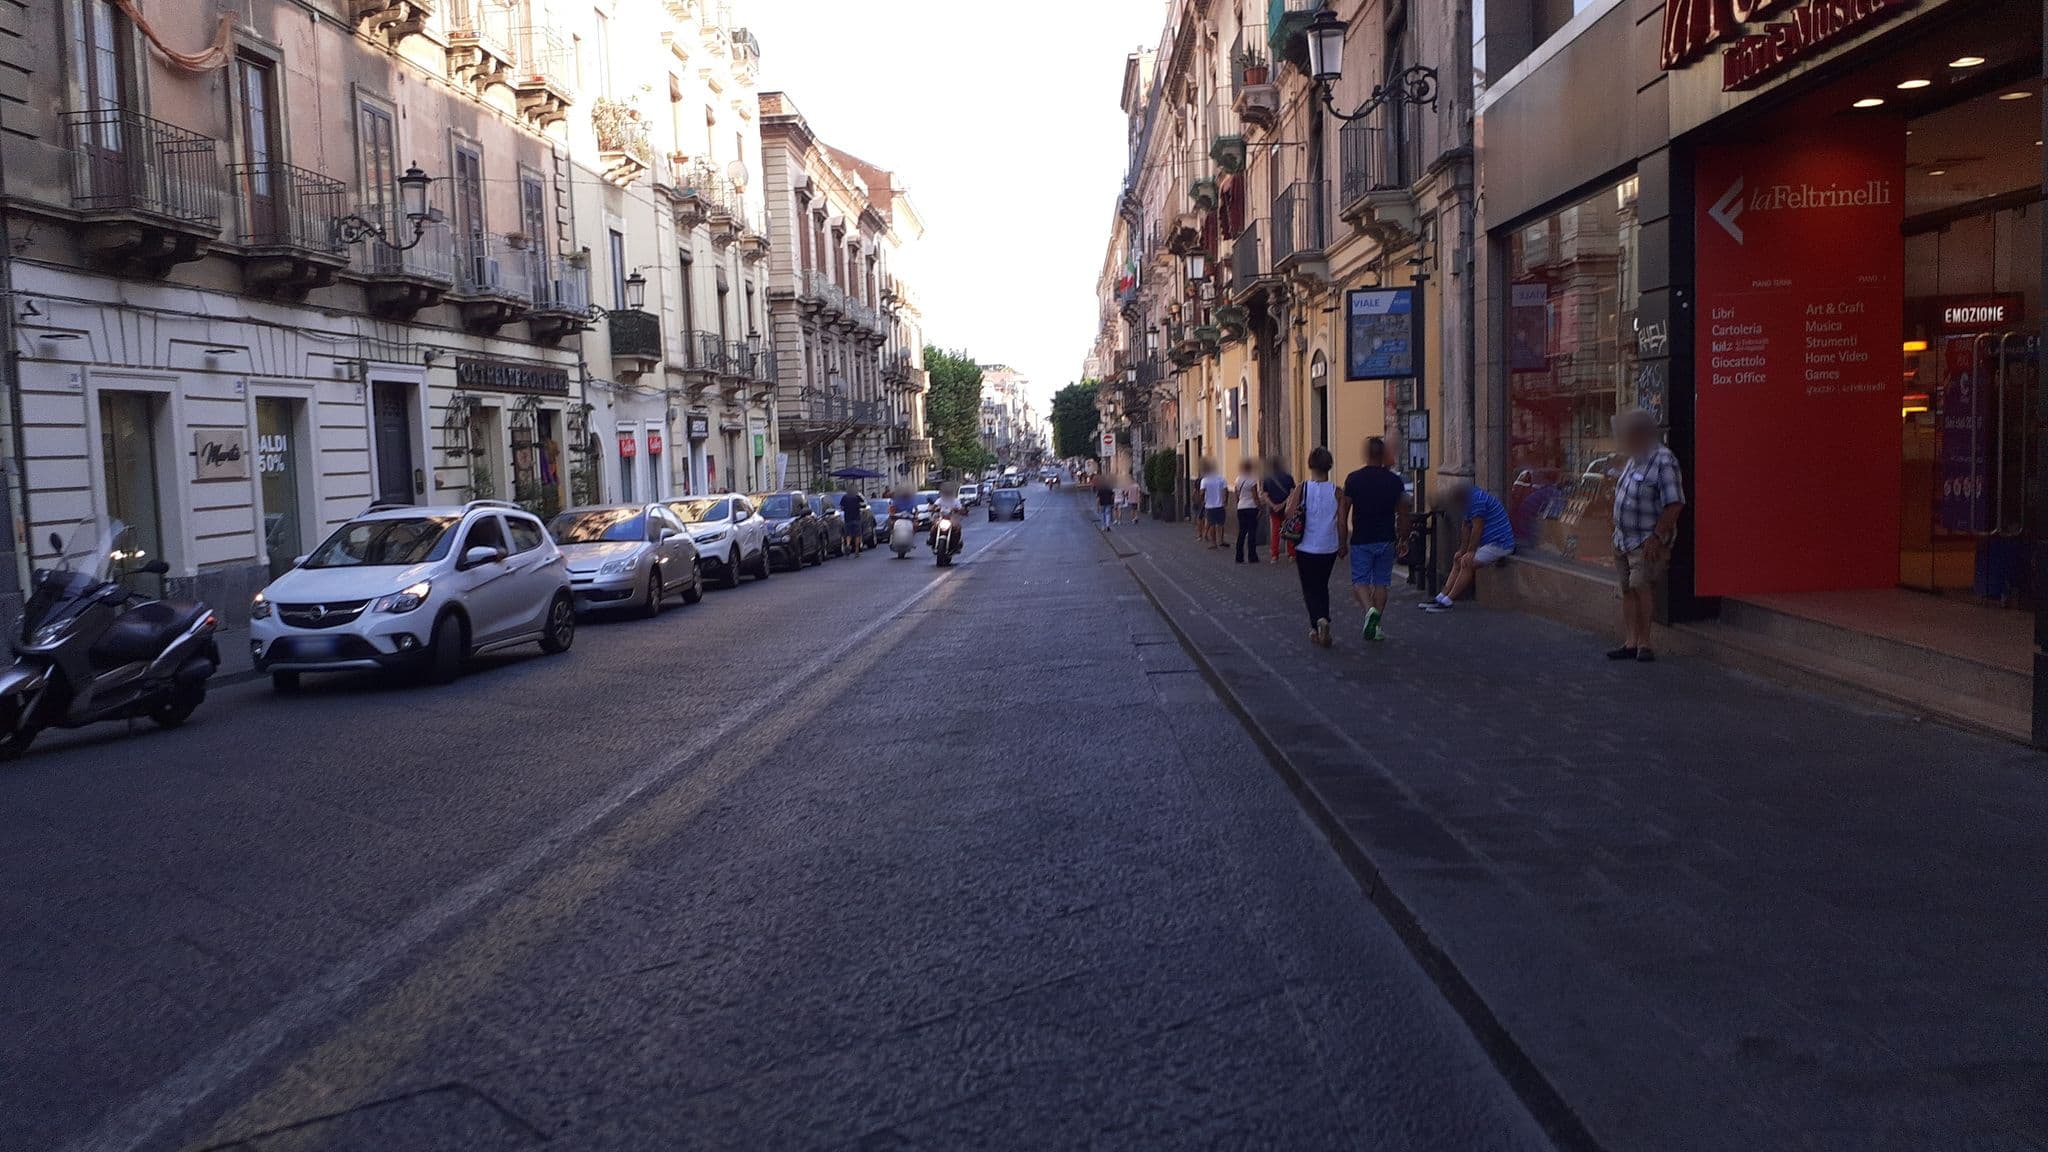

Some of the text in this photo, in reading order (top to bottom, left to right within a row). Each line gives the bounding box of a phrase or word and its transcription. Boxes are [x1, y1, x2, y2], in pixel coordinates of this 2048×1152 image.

[1354, 298, 1380, 308] VIALE
[1806, 304, 1824, 315] Art
[1838, 301, 1865, 314] Craft
[1712, 307, 1735, 319] Libri
[1945, 306, 2004, 324] EMOZIONE
[1712, 323, 1762, 336] Cartoleria
[1805, 321, 1842, 332] Musica
[1806, 335, 1857, 348] Strumenti
[1712, 356, 1766, 369] Giocattolo
[1805, 350, 1868, 364] Home Video
[1712, 371, 1766, 385] Box Office
[1805, 369, 1840, 381] Games
[257, 435, 288, 452] ALDI
